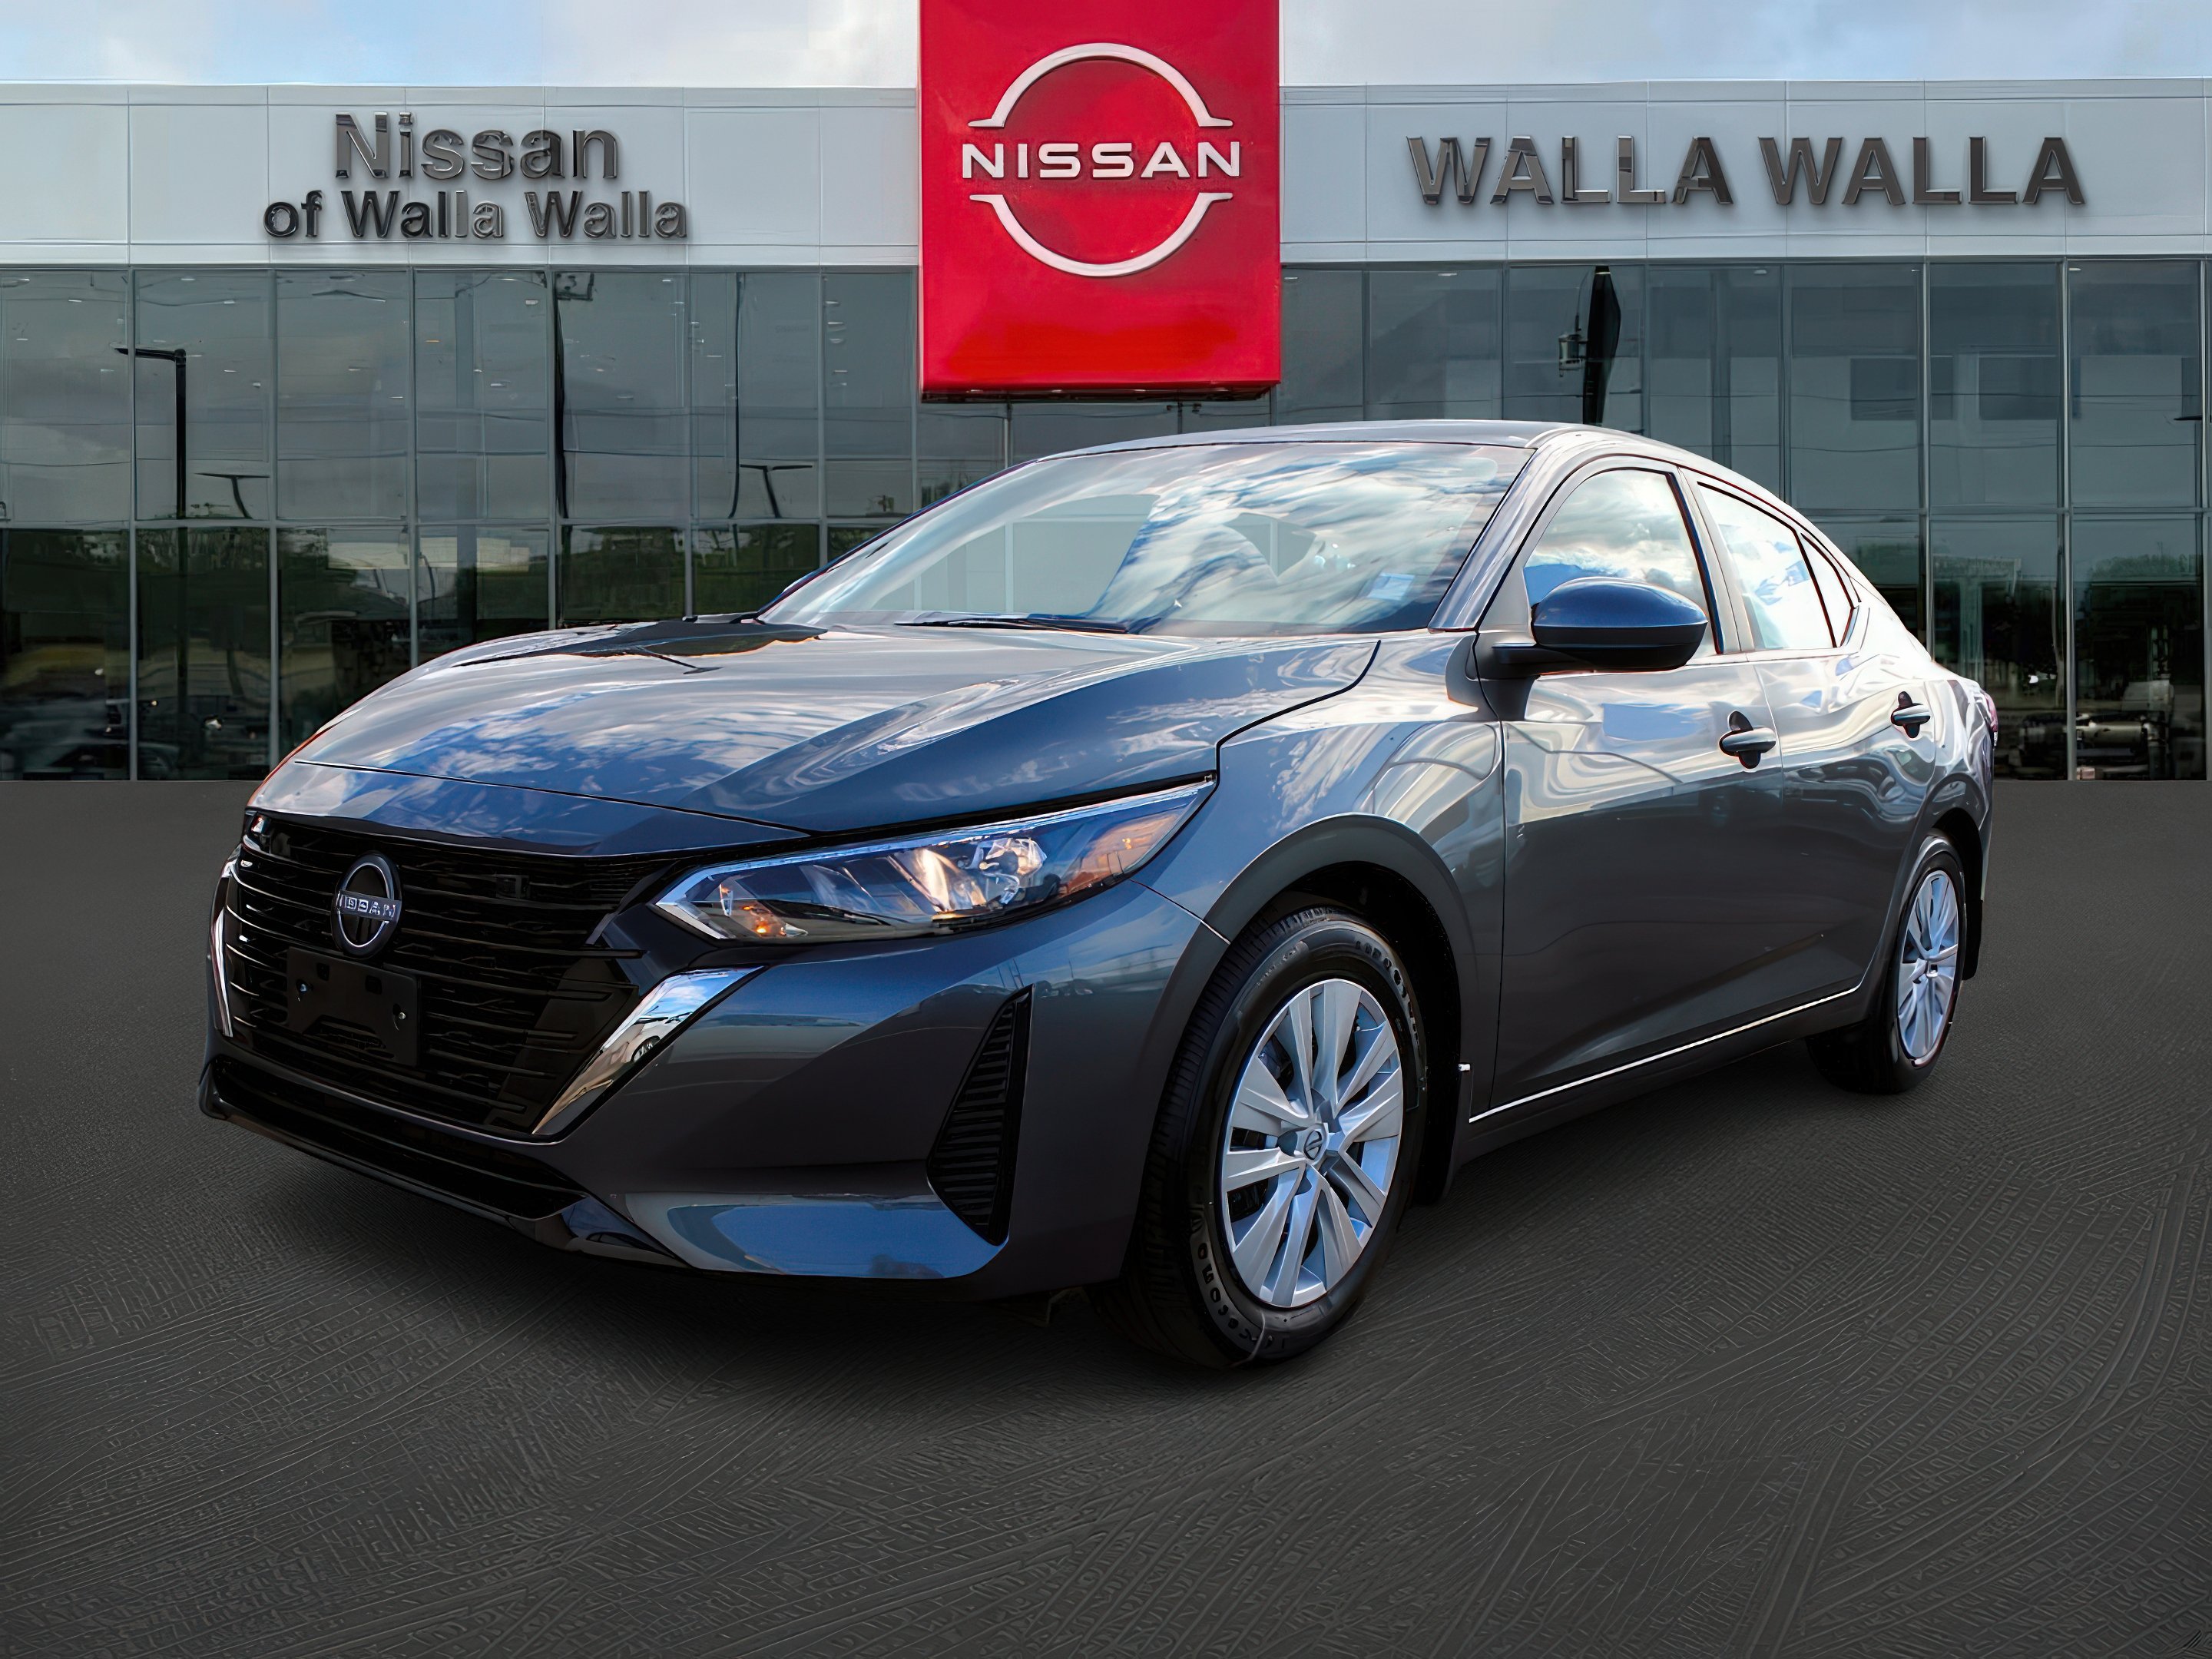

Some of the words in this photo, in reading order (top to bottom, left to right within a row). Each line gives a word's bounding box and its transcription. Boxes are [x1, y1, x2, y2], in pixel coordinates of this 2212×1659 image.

[335, 111, 618, 180] Nissan
[962, 141, 1240, 178] NISSAN
[1406, 135, 1734, 205] WALLA
[1757, 136, 2086, 205] WALLA
[263, 190, 323, 238] of
[340, 190, 505, 238] Walla
[524, 190, 687, 238] Walla
